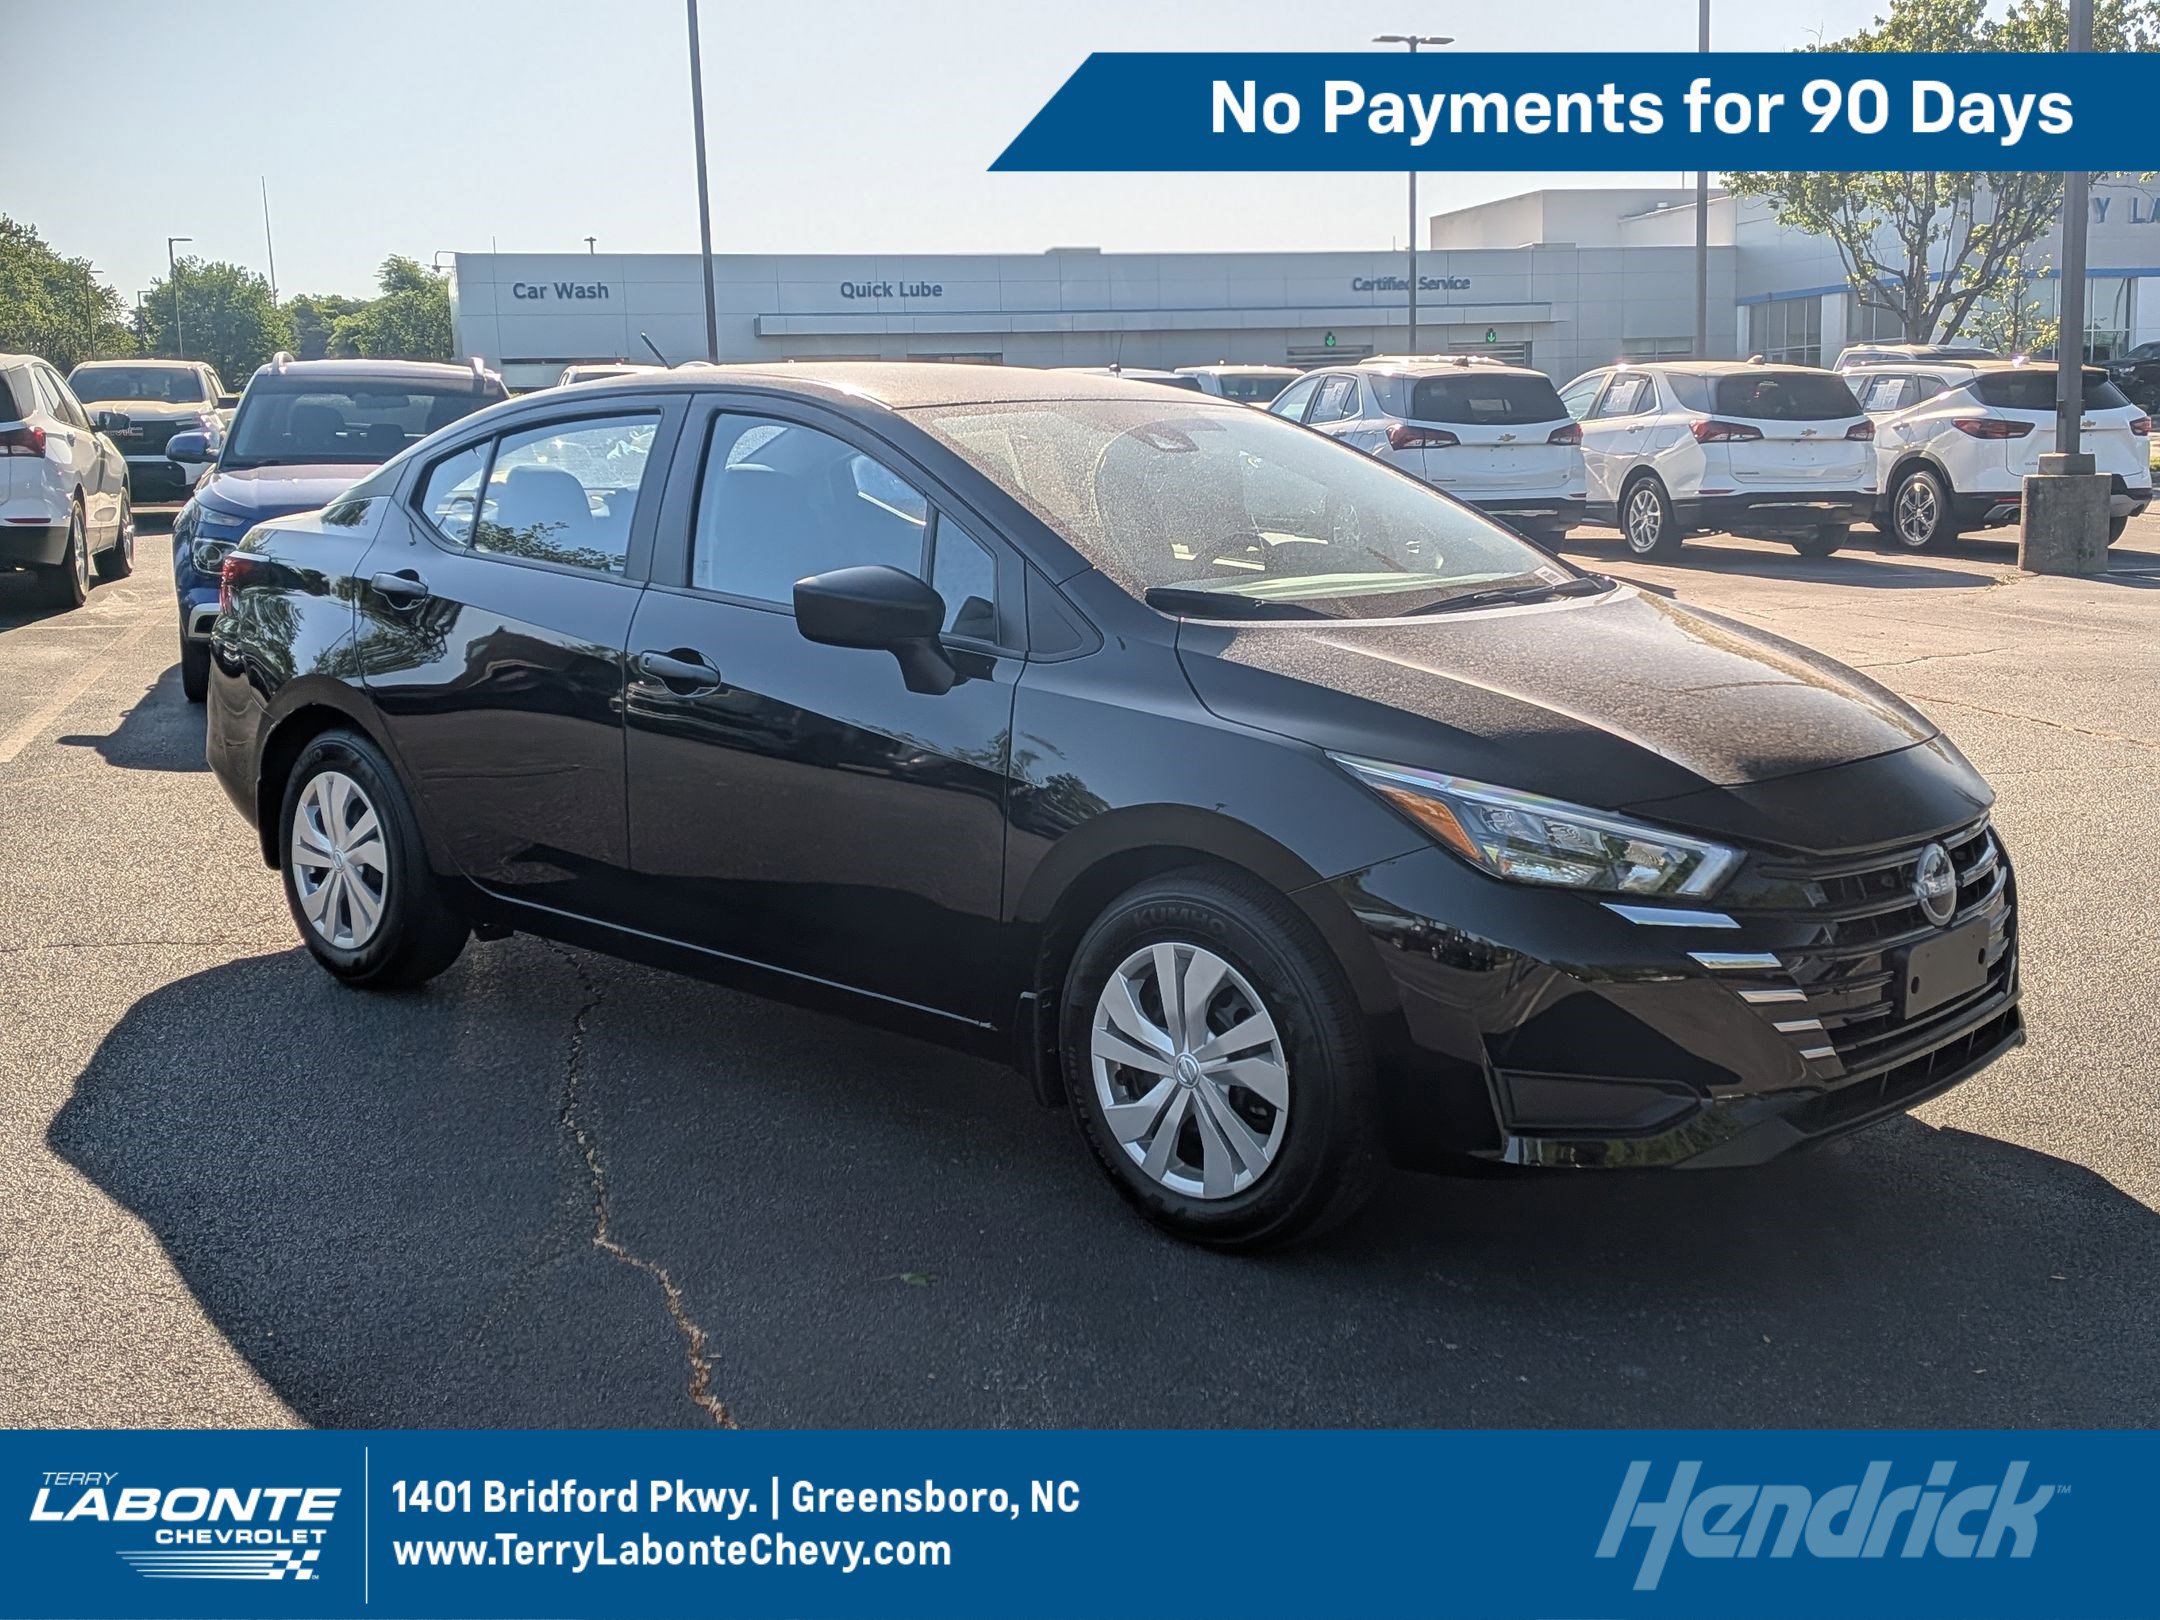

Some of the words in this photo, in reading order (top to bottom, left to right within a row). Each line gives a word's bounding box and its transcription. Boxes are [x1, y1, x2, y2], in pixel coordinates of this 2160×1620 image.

[512, 282, 547, 300] Car
[553, 281, 609, 300] Wash
[840, 281, 894, 299] Quick
[899, 281, 943, 298] Lube
[1417, 276, 1471, 290] Service
[1133, 906, 1227, 934] KUMHO
